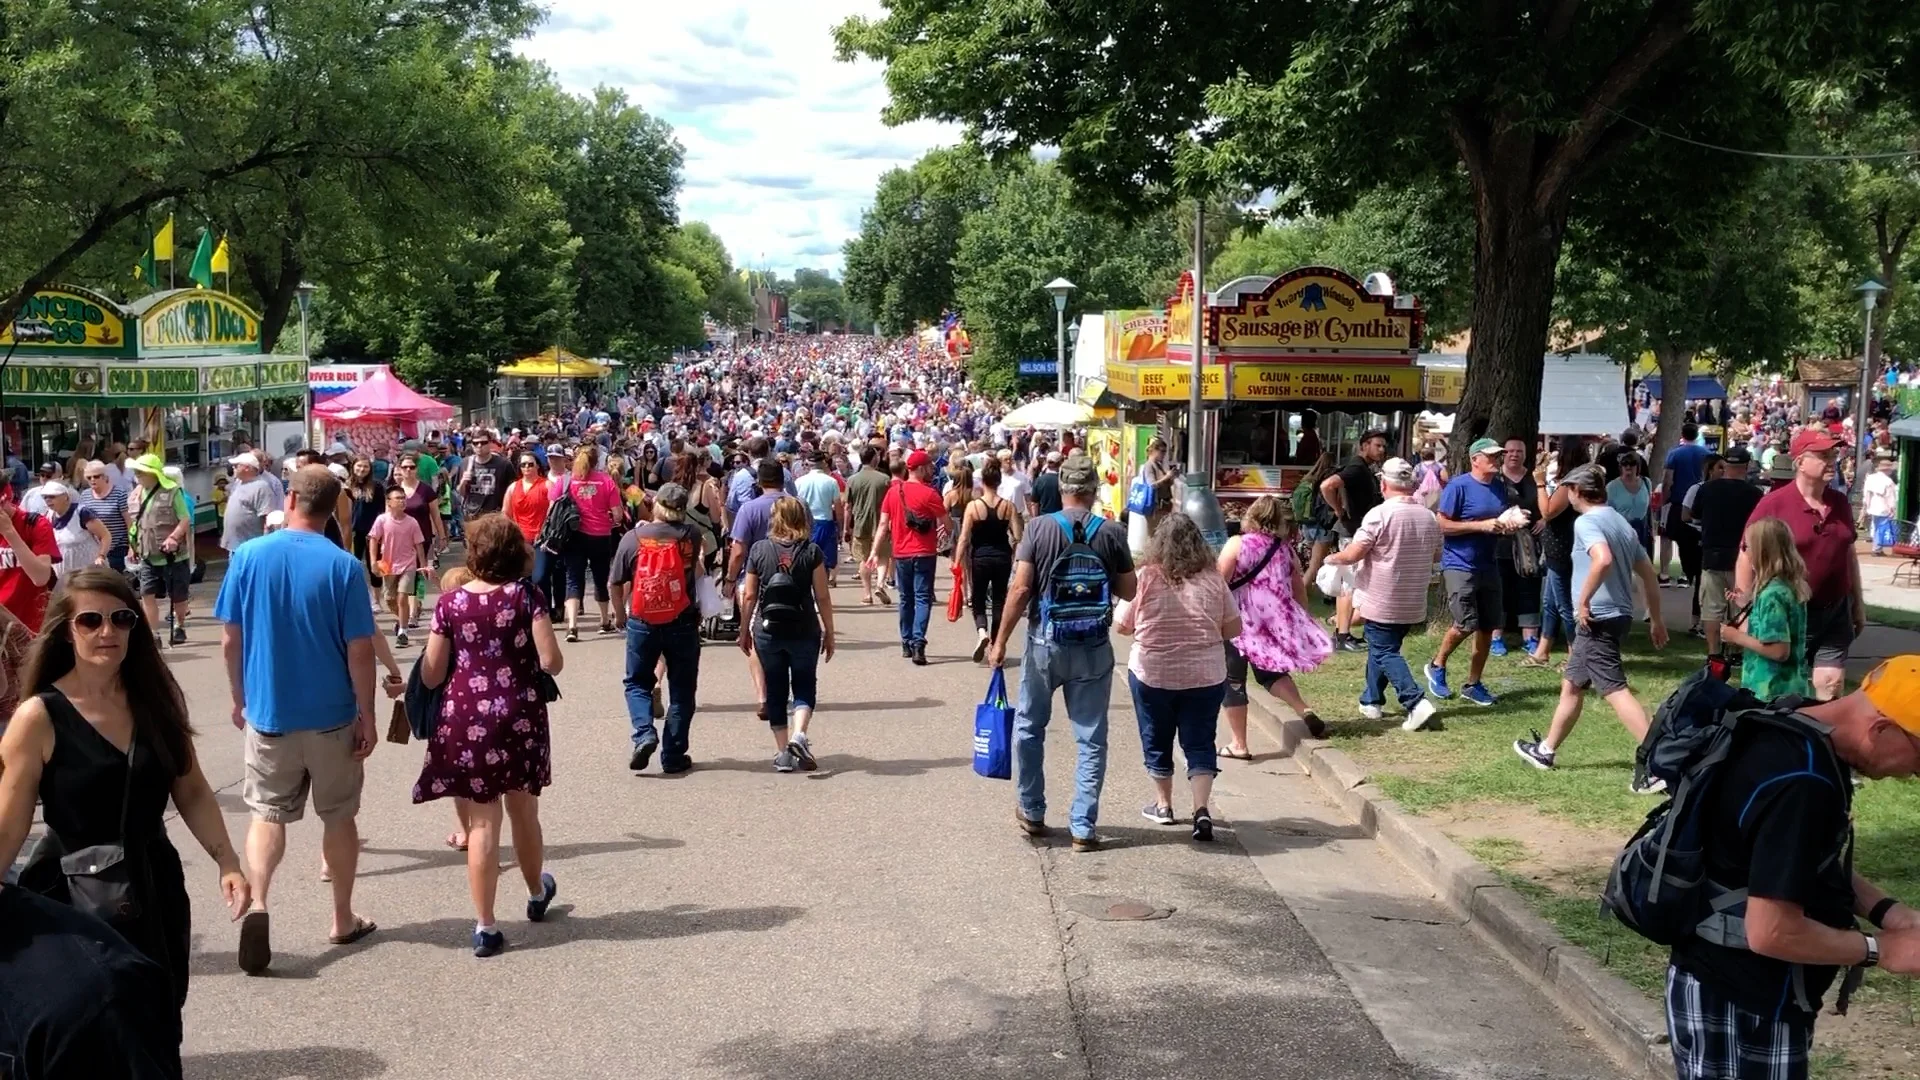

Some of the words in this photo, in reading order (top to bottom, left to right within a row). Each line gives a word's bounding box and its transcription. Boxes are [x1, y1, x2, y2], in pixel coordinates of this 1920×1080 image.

[1323, 286, 1355, 312] Winning
[16, 296, 104, 325] ONCHO
[157, 299, 212, 344] PONCHO
[214, 302, 247, 341] DOGS
[1223, 317, 1300, 344] Sausage
[1325, 317, 1405, 343] Cynthia
[1020, 362, 1045, 373] NELSON
[1047, 362, 1055, 372] ST
[27, 367, 70, 392] DOGS
[109, 370, 143, 392] COLD
[147, 370, 196, 392] DRINKS
[337, 372, 358, 381] RIDE
[1144, 374, 1164, 384] BEEF
[1260, 372, 1290, 382] CAJUN
[1302, 373, 1343, 383] GERMAN
[1354, 374, 1390, 385] ITALIAN
[1142, 385, 1167, 395] JERKY
[1248, 385, 1291, 396] SWEDISH
[1301, 386, 1337, 397] CREOLE
[1347, 387, 1404, 398] MINNESOTA
